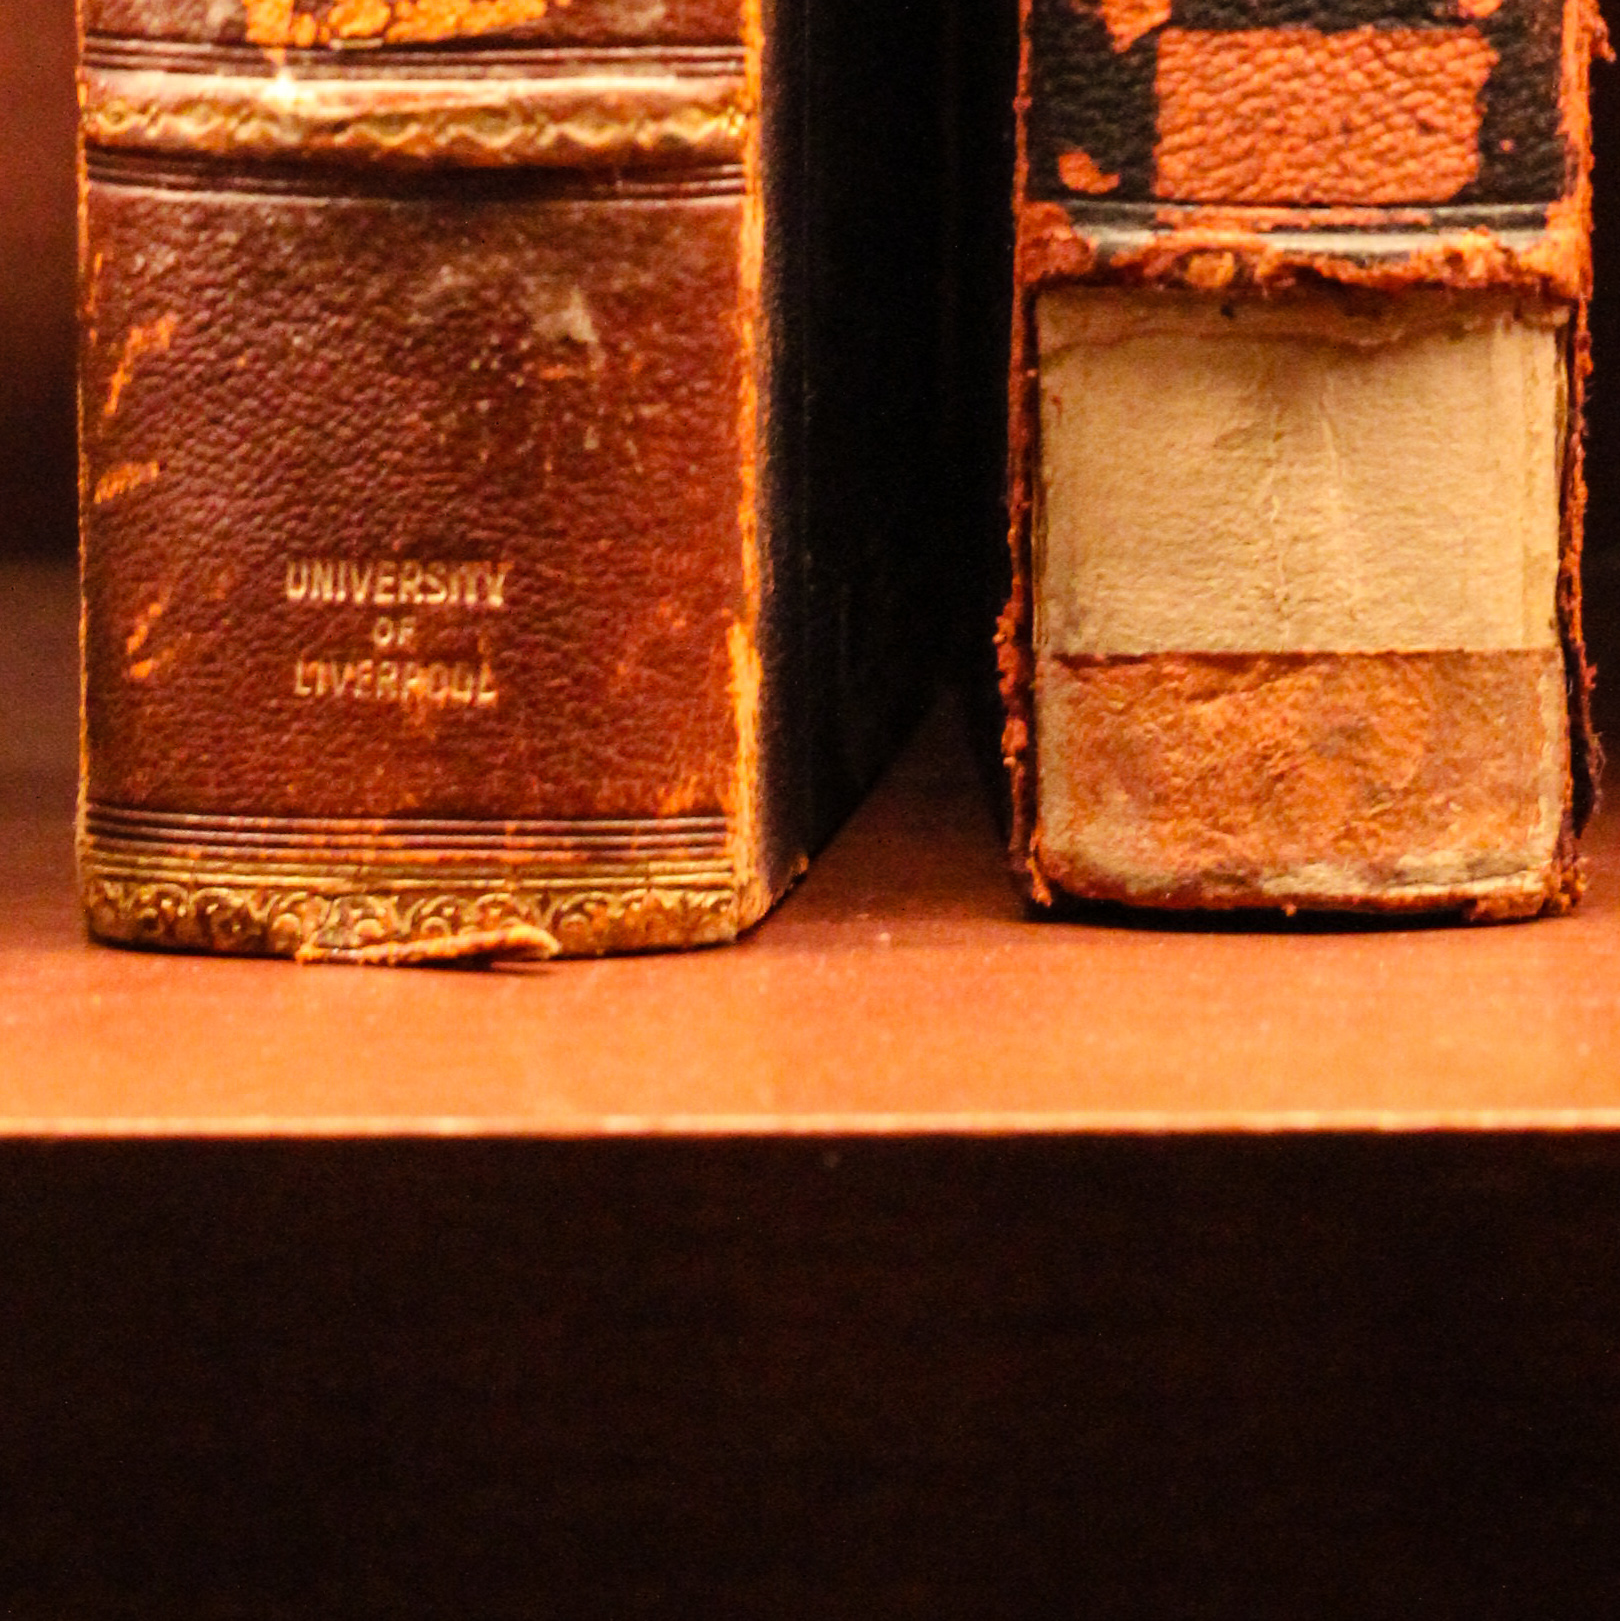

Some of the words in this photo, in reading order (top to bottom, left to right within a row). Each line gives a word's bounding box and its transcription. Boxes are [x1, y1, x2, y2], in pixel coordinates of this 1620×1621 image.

[286, 560, 514, 607] UNIVERSITY
[371, 615, 417, 647] OF
[294, 659, 499, 706] LIVERPOOL
